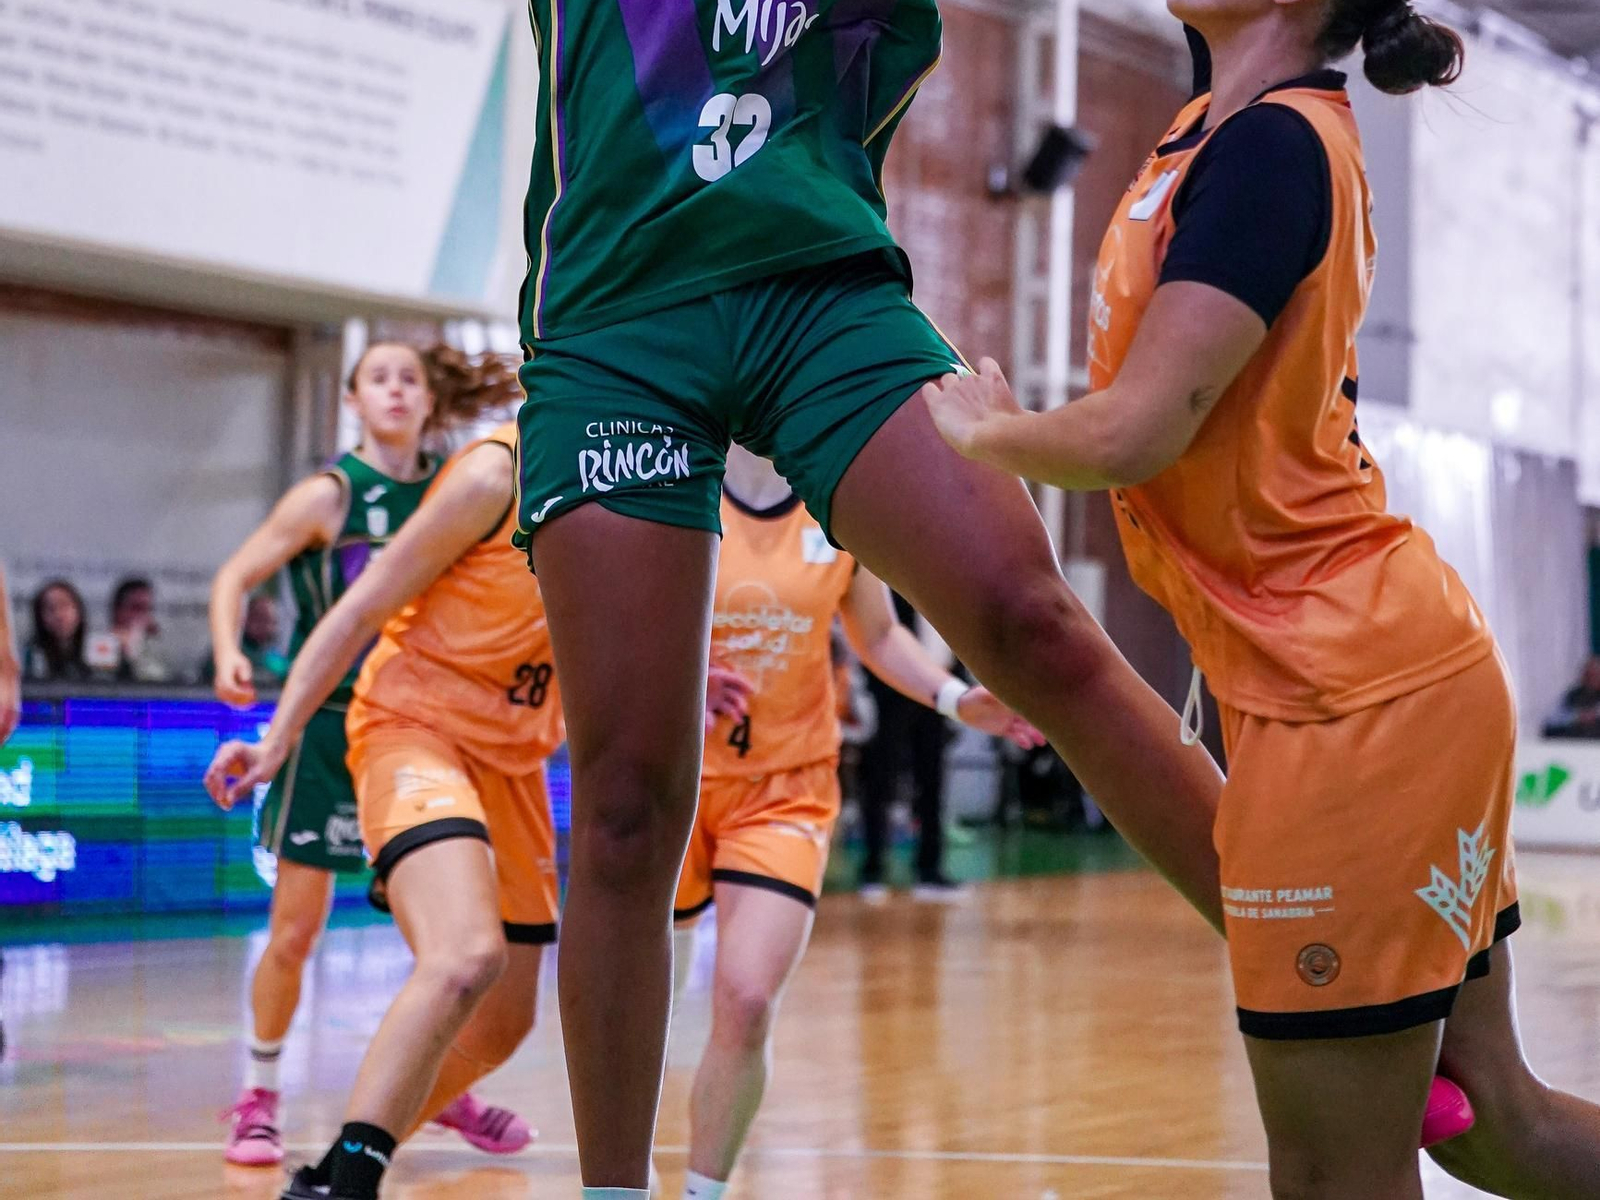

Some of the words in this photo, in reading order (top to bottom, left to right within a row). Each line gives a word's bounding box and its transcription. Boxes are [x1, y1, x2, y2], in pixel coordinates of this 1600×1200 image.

[692, 93, 772, 182] 32
[506, 662, 553, 709] 28
[727, 714, 752, 759] 4
[1276, 886, 1333, 903] PEAMAR
